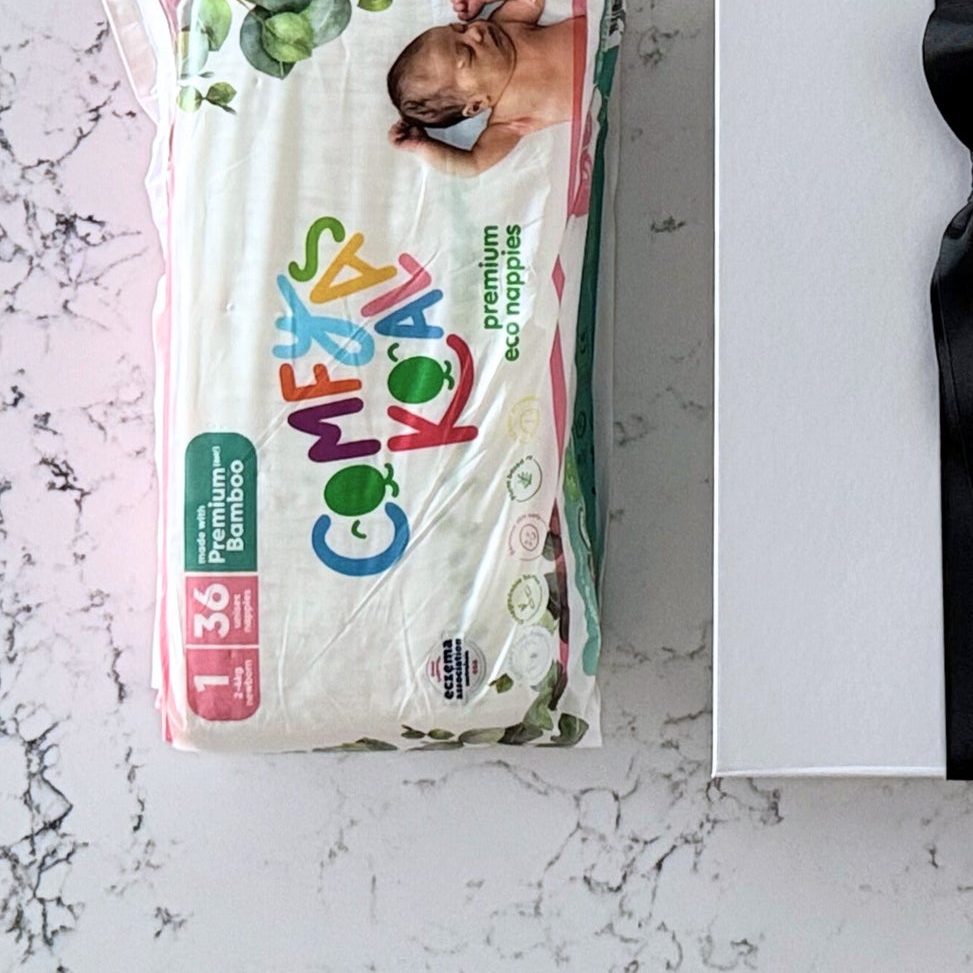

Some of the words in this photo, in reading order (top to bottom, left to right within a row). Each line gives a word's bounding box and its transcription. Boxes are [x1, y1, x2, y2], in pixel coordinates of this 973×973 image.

[478, 225, 503, 329] premium
[501, 224, 525, 316] nappies
[288, 216, 478, 452] KOALAS
[505, 322, 520, 362] eco
[272, 275, 410, 577] COMFY
[197, 505, 206, 529] with
[207, 468, 226, 564] Premium
[226, 459, 244, 552] Bamboo
[197, 532, 206, 564] made
[193, 583, 230, 638] 36
[233, 593, 242, 629] unisex
[243, 589, 253, 633] nappies
[193, 675, 229, 693] 1
[244, 659, 254, 706] newborn
[443, 639, 454, 700] eczema
[455, 638, 463, 700] association
